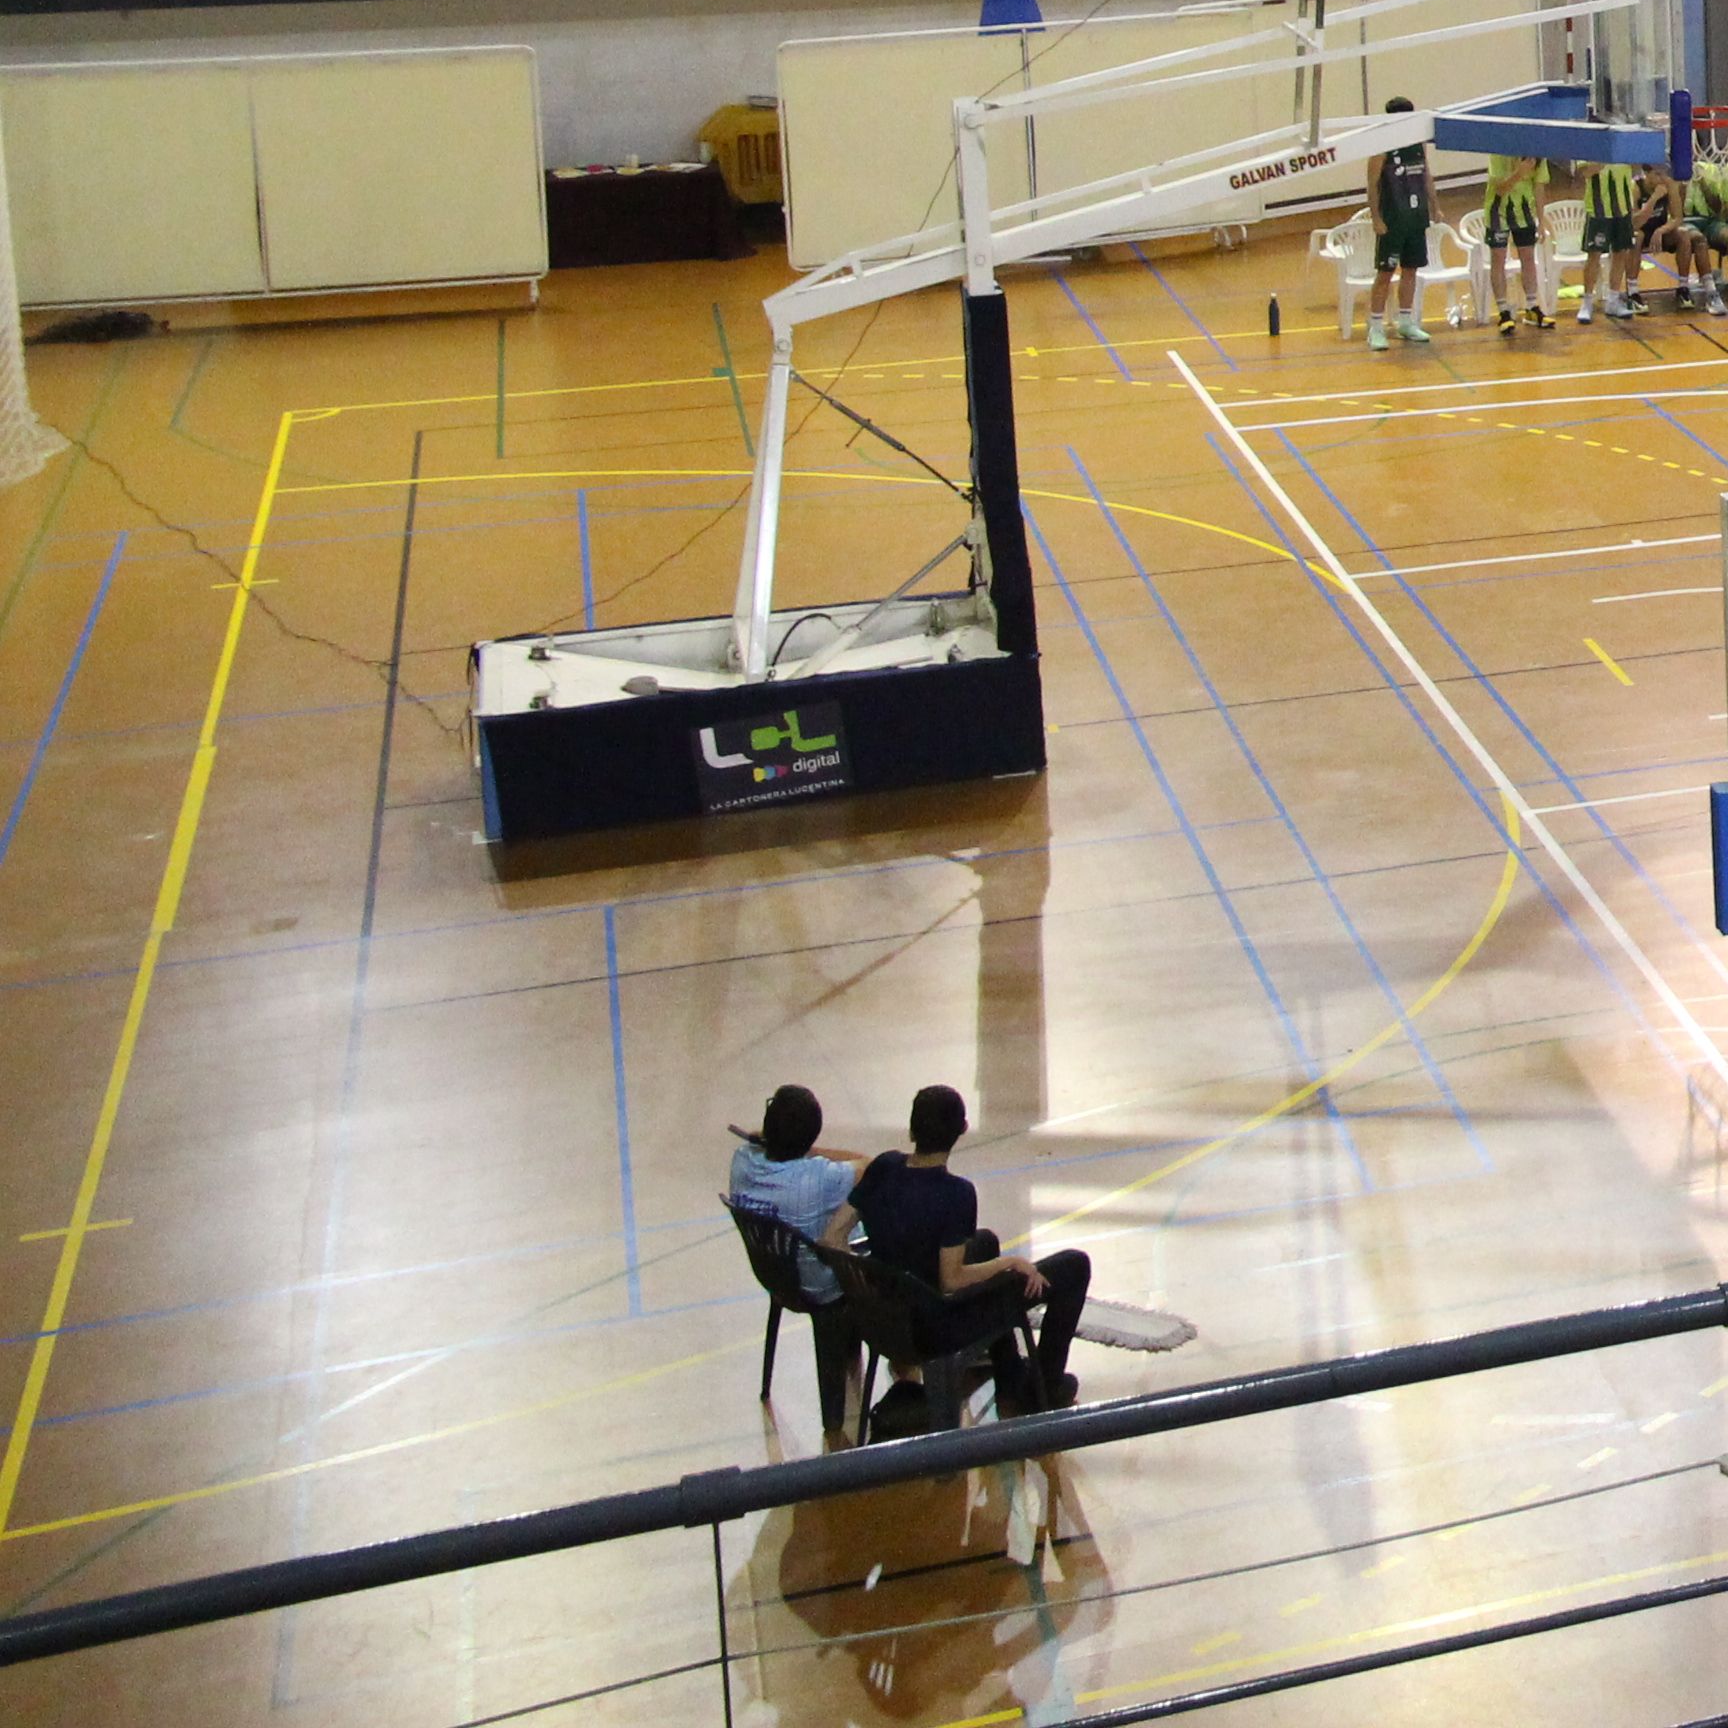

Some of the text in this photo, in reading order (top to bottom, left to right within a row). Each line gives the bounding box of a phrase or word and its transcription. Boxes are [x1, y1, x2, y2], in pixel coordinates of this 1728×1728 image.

[1229, 147, 1336, 190] GALVAN SPORT
[792, 750, 841, 774] digital
[725, 790, 787, 808] CARTONERA
[788, 778, 845, 796] LUCENTINA
